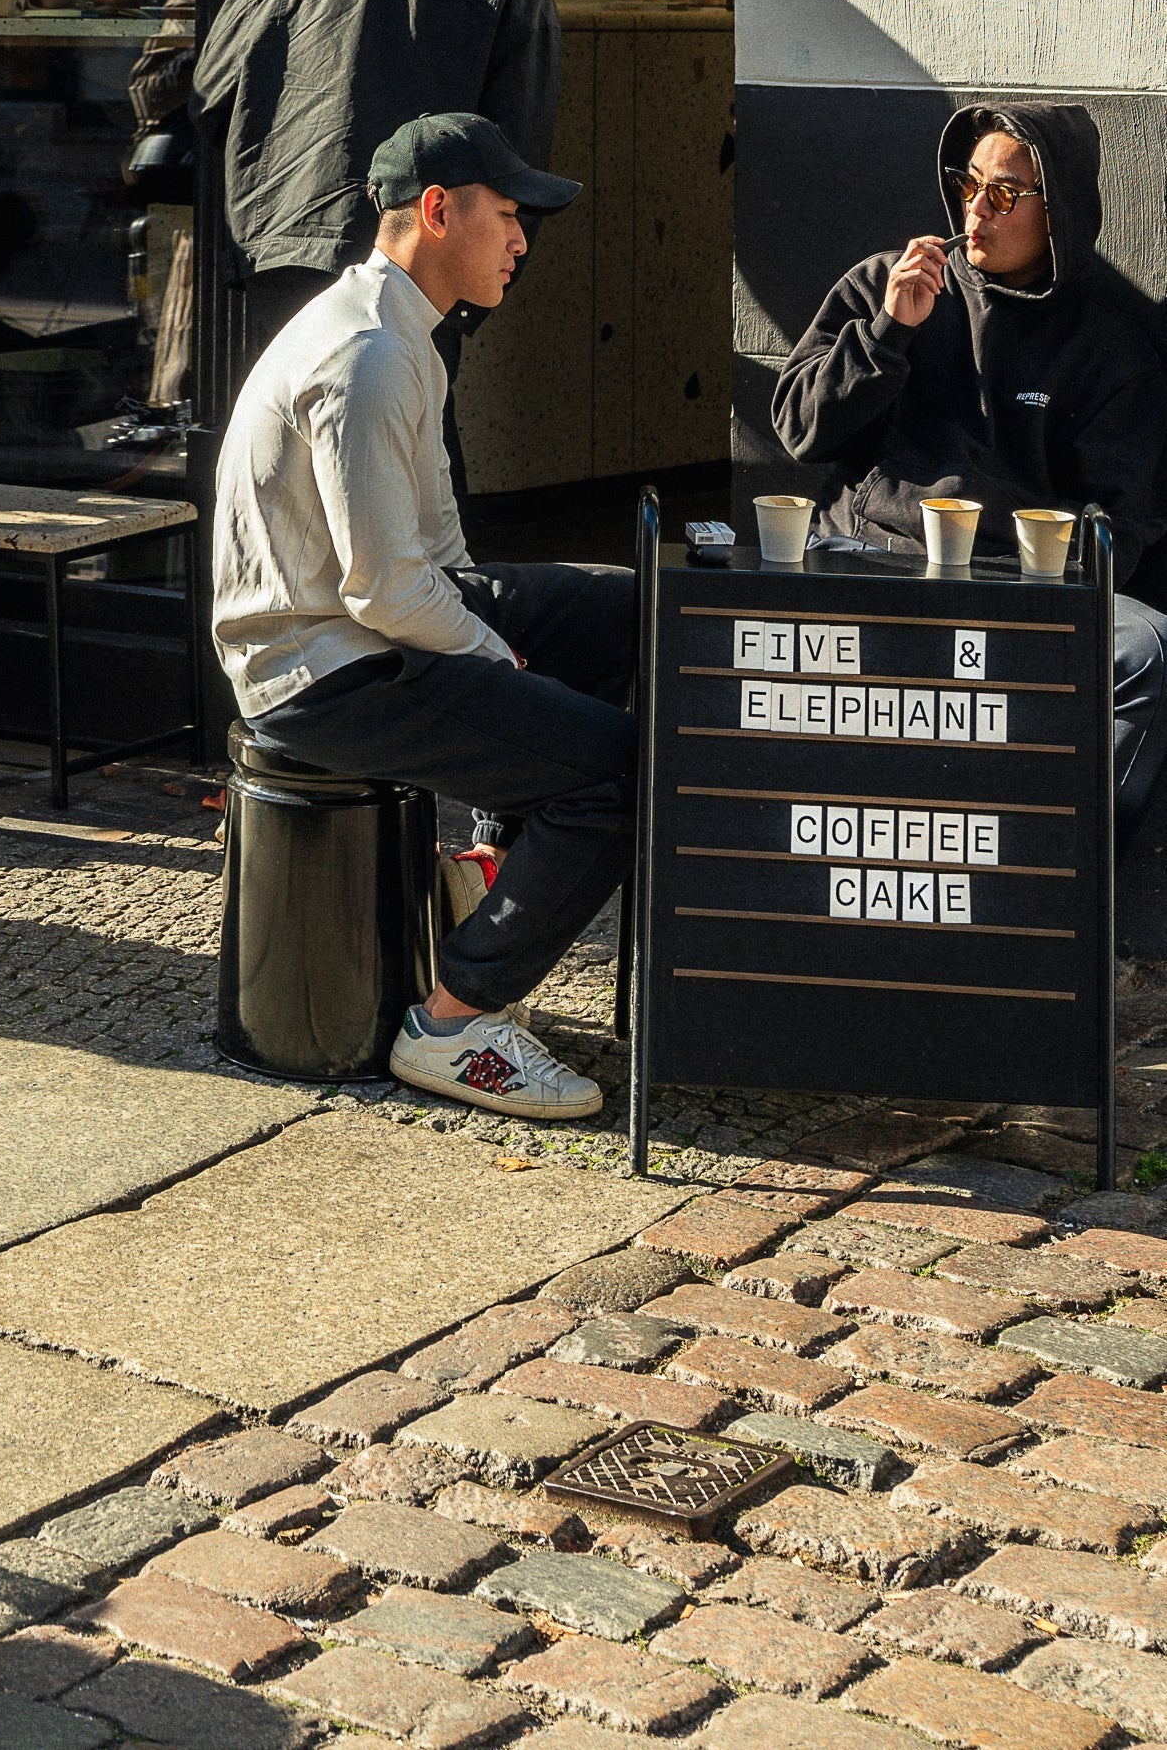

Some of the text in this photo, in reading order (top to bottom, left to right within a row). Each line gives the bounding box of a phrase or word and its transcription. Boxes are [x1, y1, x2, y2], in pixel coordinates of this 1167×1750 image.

[740, 630, 982, 669] FIVE &
[746, 689, 1004, 733] ELEPHANT
[796, 814, 994, 854] COFFEE
[834, 878, 967, 913] CAKE
